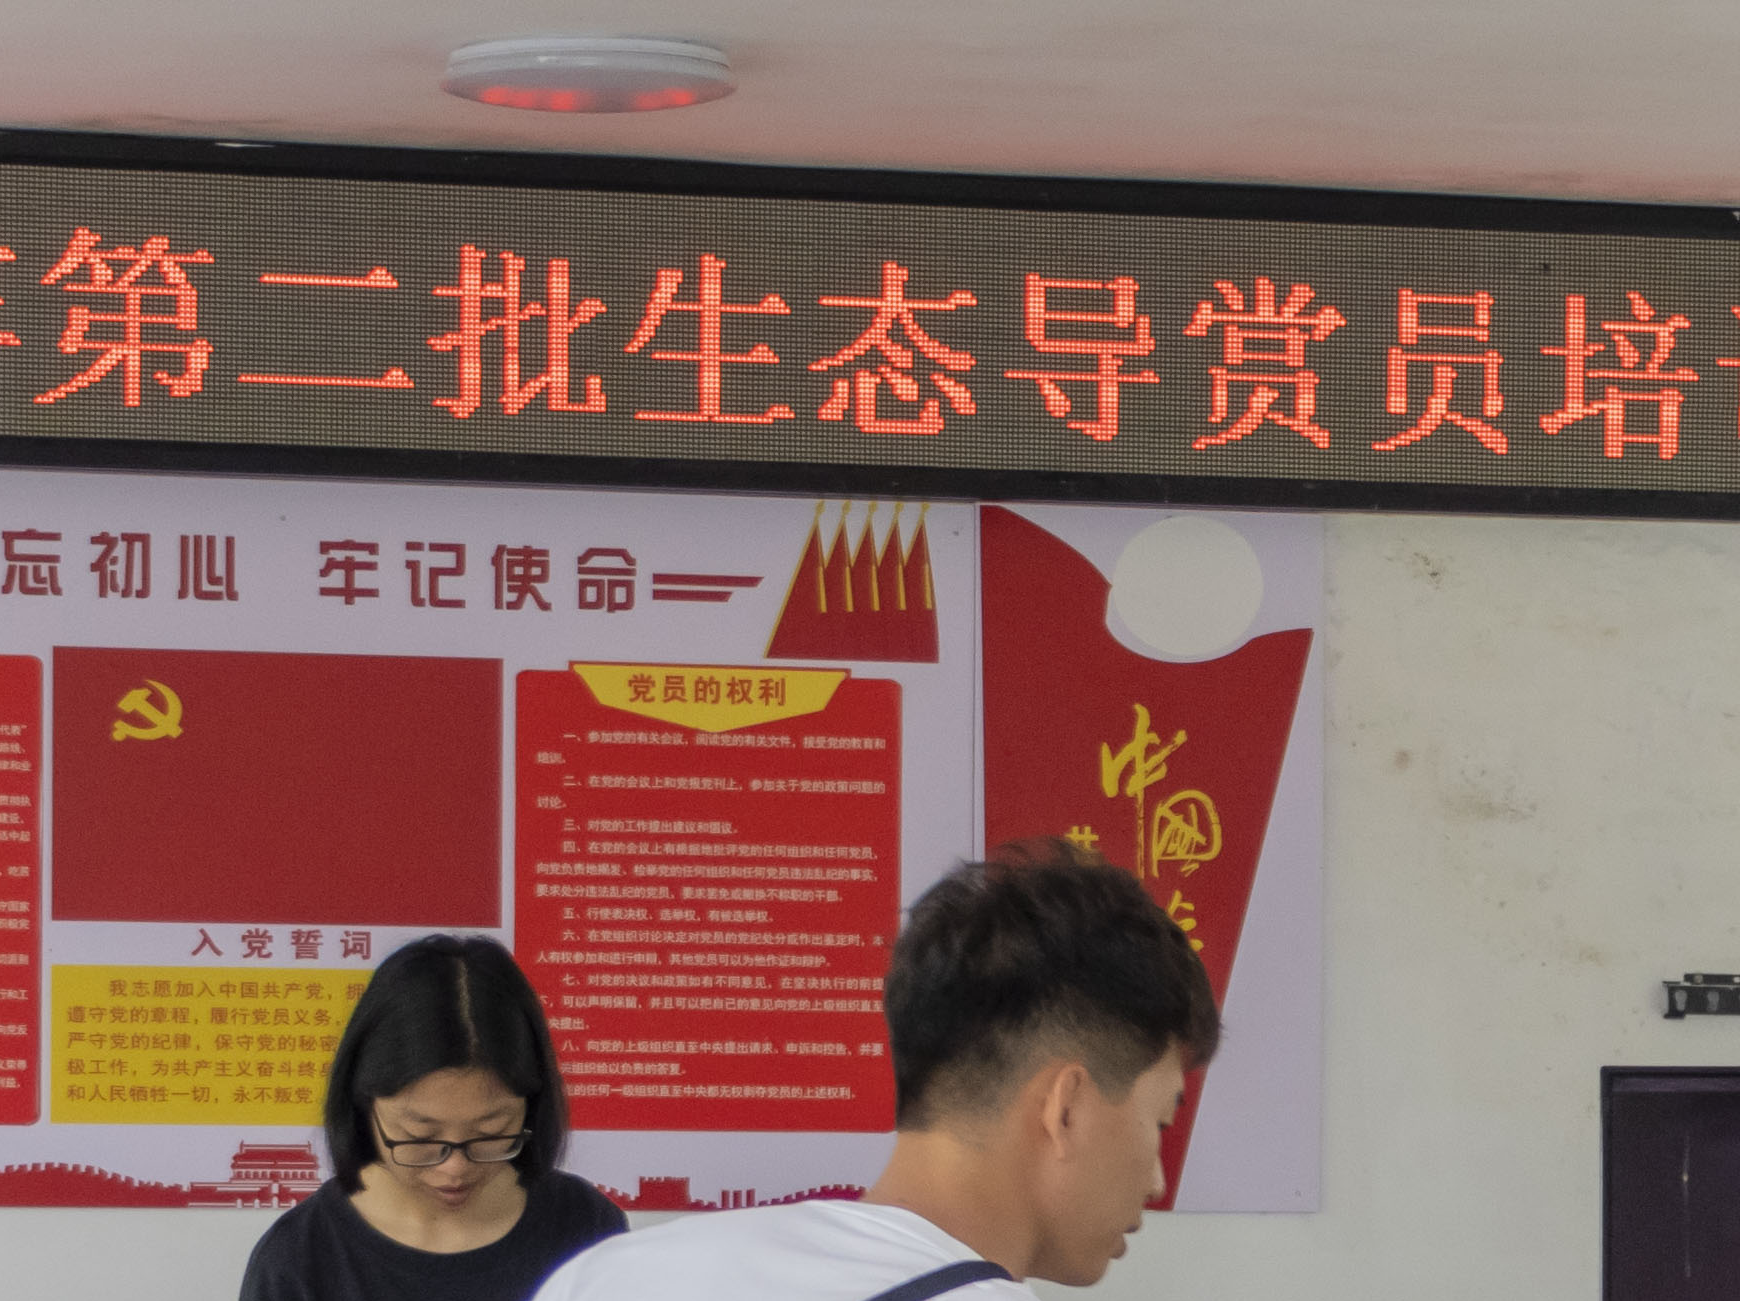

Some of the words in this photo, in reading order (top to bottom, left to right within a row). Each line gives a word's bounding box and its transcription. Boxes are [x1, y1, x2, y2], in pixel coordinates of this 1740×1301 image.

[318, 539, 637, 613] 牢记使命
[627, 674, 787, 706] 党员的权利
[190, 928, 372, 960] 入党誓词
